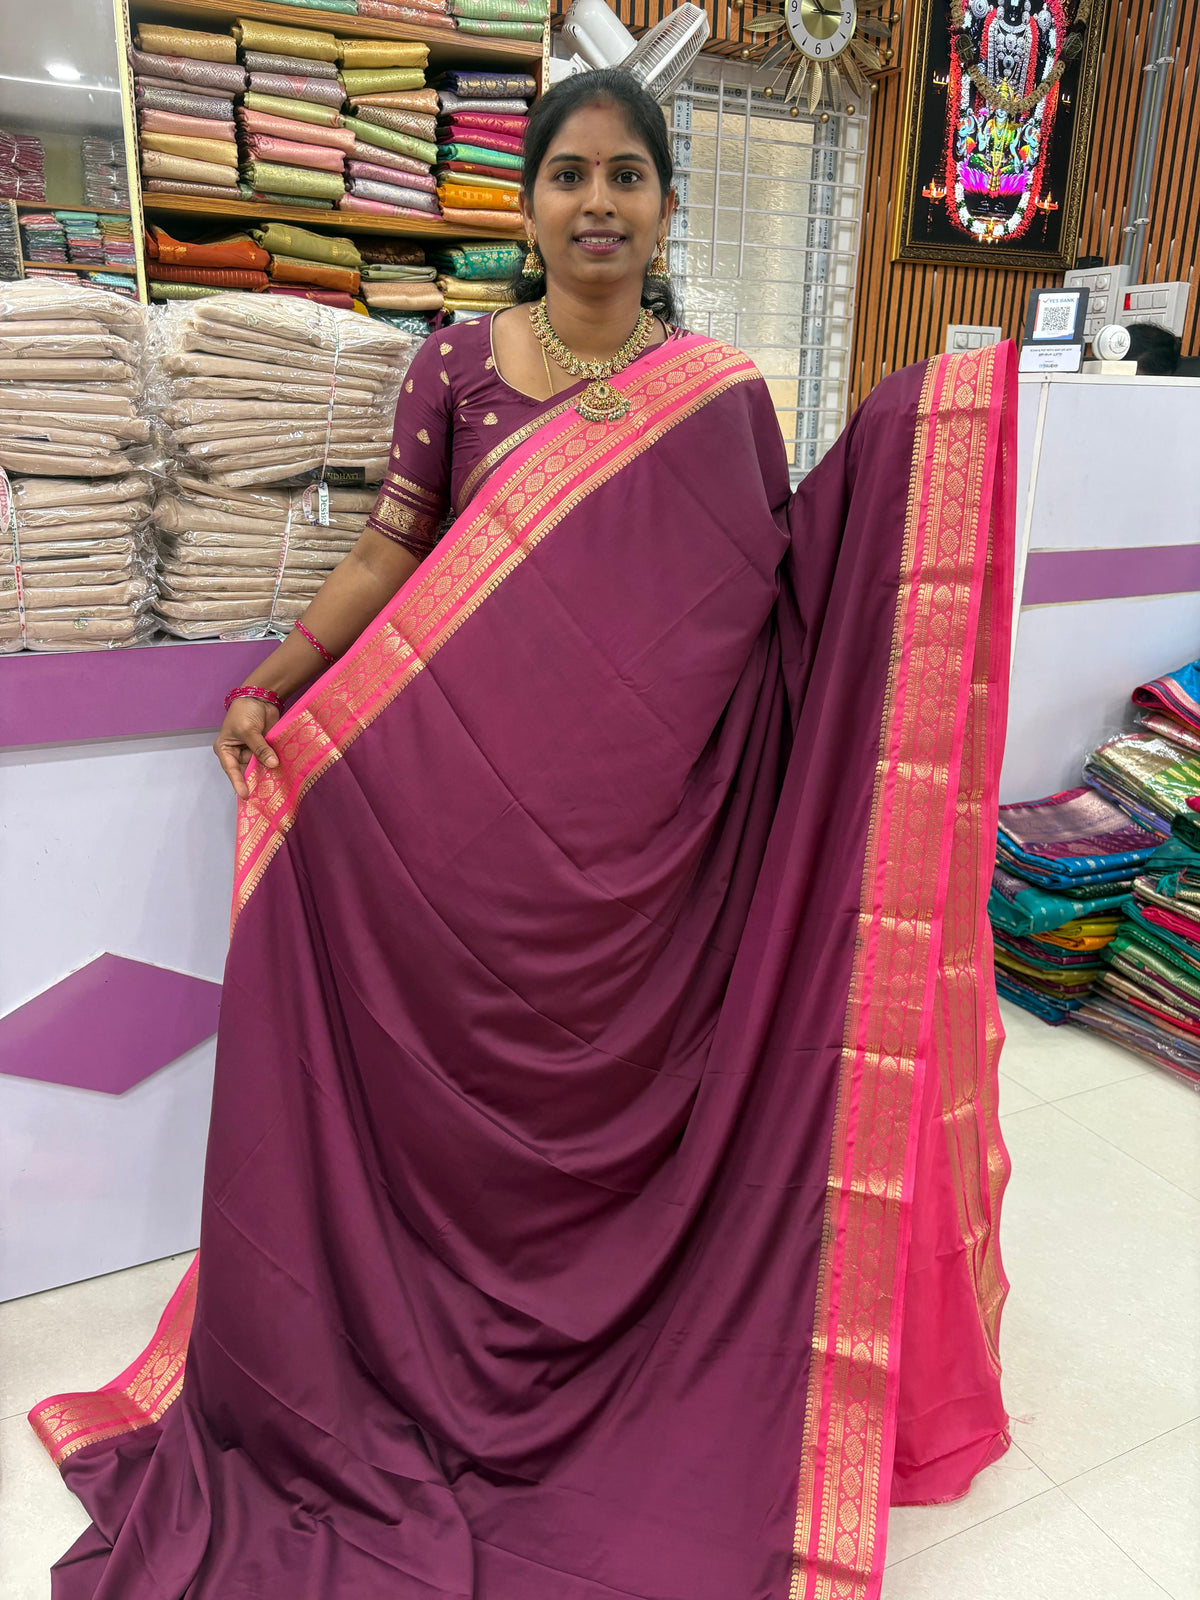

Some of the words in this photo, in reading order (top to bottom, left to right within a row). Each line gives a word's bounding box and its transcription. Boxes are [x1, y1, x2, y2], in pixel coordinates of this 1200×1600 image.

[791, 0, 798, 13] 9
[845, 11, 852, 24] 3
[815, 42, 821, 55] 6
